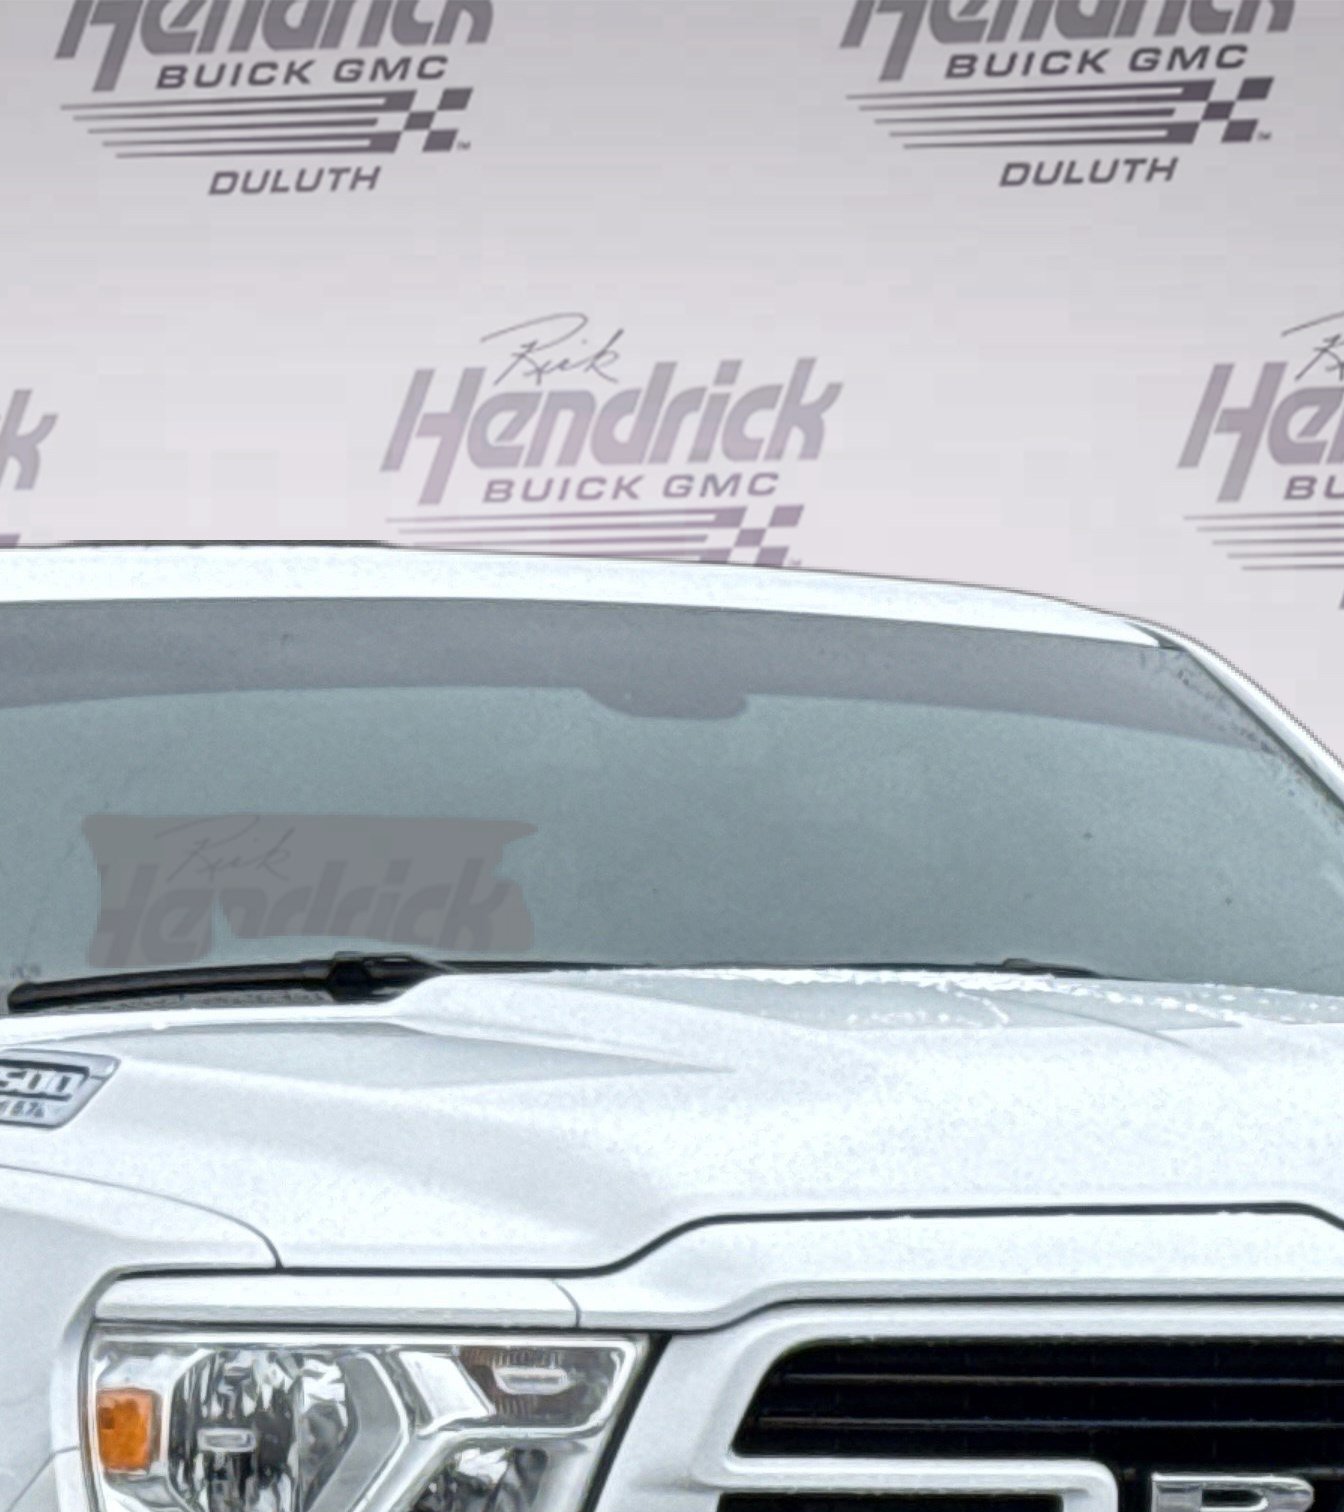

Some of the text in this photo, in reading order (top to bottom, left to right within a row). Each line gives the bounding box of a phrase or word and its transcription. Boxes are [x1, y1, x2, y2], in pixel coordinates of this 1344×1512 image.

[155, 55, 448, 90] BUICK GMC
[944, 44, 1248, 79] BUICK GMC
[208, 166, 381, 195] DULUTH
[999, 157, 1179, 187] DULUTH
[379, 357, 844, 506] Hendrick
[483, 472, 779, 503] BUICK GMC
